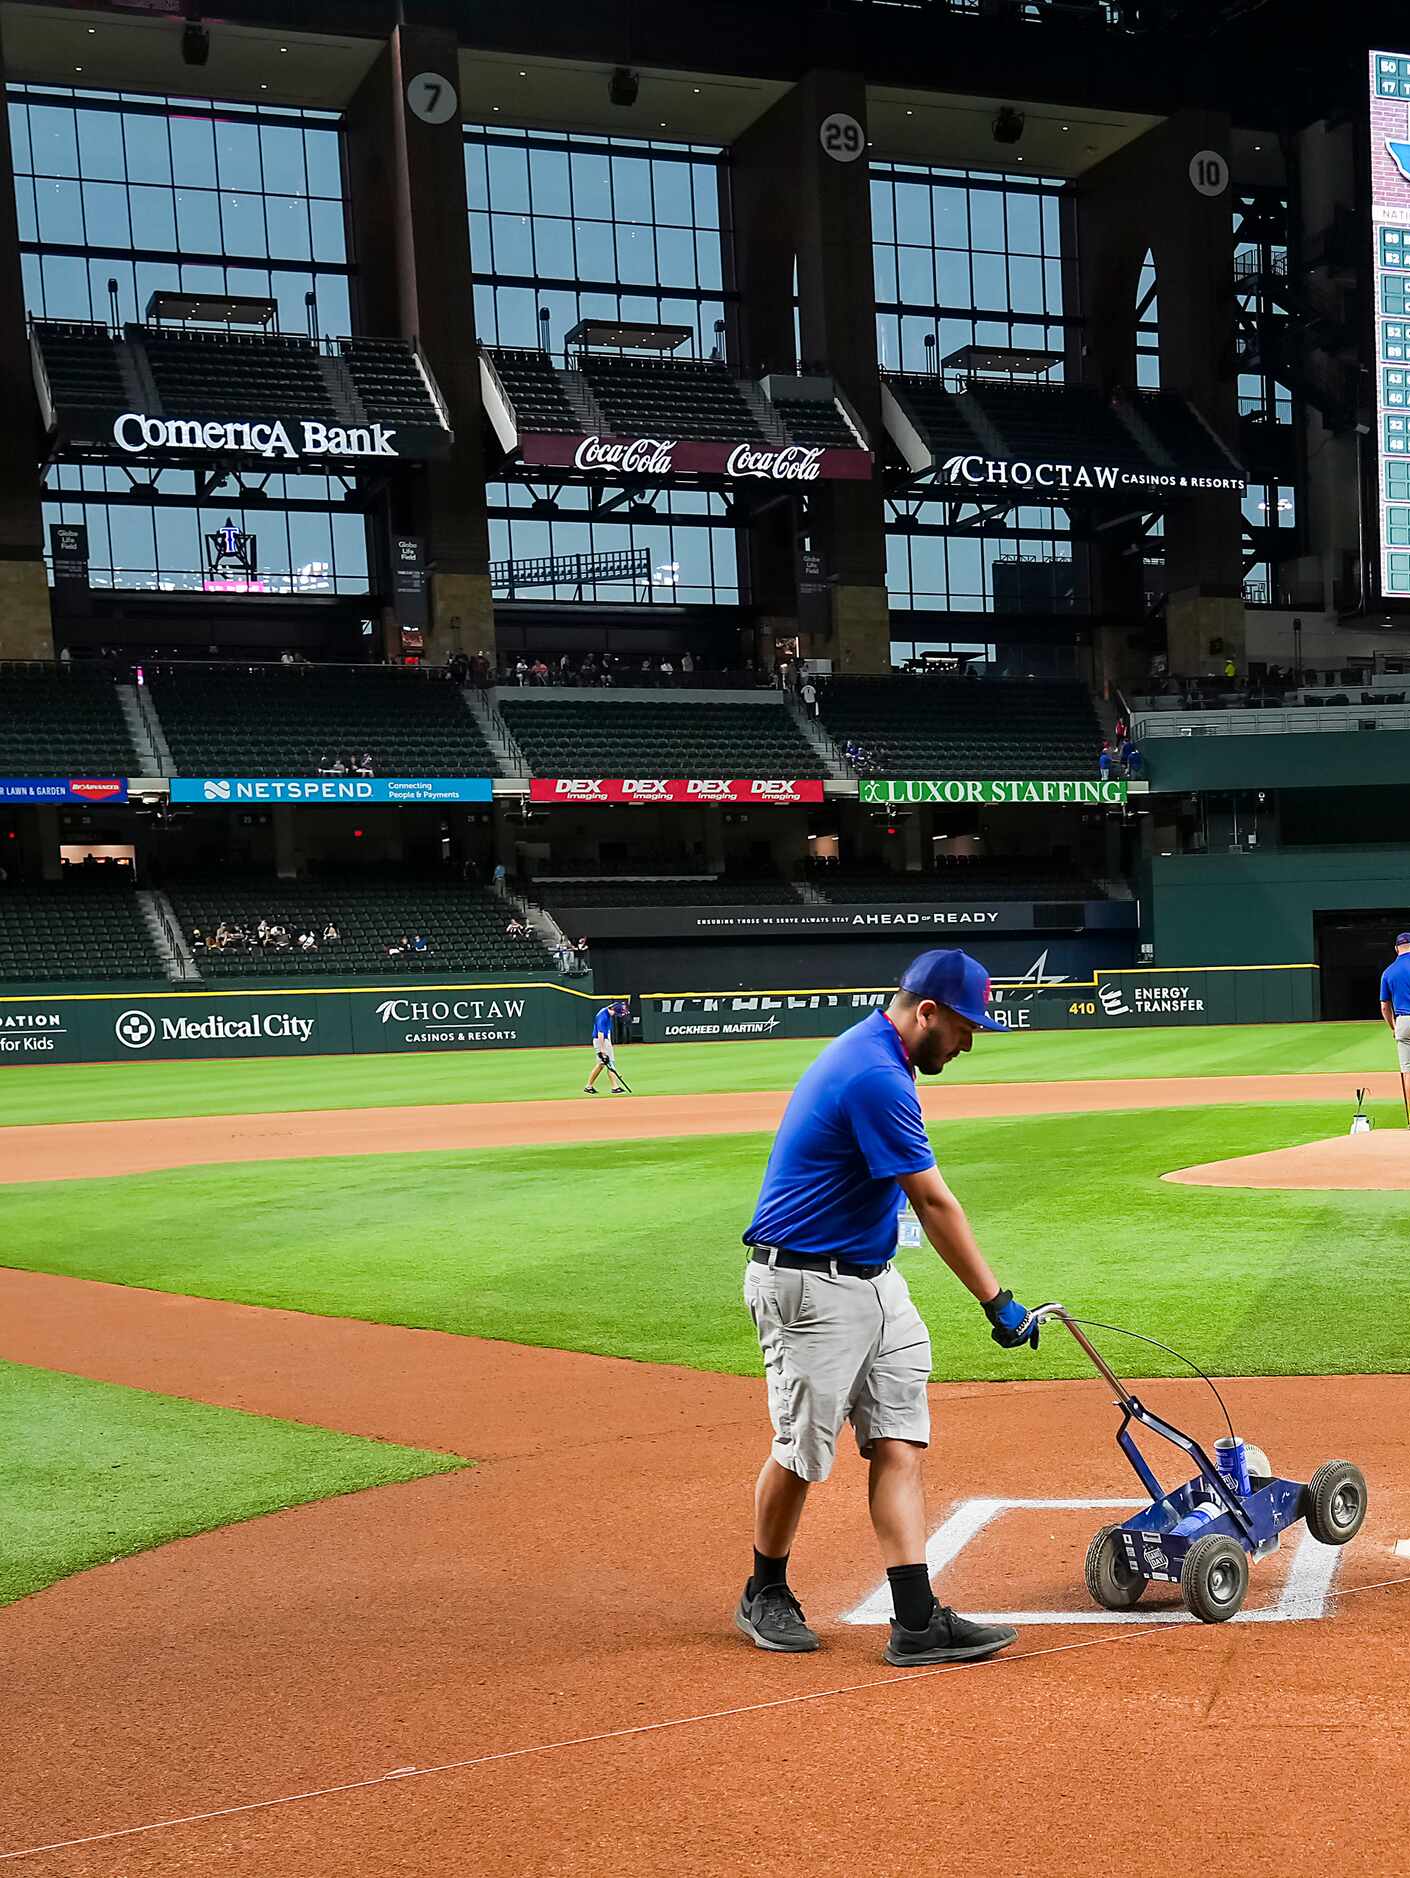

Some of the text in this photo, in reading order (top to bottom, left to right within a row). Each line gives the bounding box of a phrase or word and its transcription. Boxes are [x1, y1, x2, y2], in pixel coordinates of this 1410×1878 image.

[424, 83, 442, 112] 7
[826, 124, 858, 152] 29
[1197, 160, 1220, 186] 10
[301, 421, 399, 456] Bank
[575, 436, 677, 474] Coca-Cola
[727, 443, 825, 480] Coca-Cola
[961, 456, 1245, 489] CHOCTAW CASINOS & RESORTS
[6, 787, 27, 796] LAWN
[29, 787, 35, 796] &
[36, 787, 66, 796] GARDEN
[237, 783, 373, 797] NETSPEND
[388, 782, 432, 792] Connecting
[555, 779, 603, 793] DEX
[622, 779, 669, 793] DEX
[687, 779, 734, 793] DEX
[751, 779, 797, 793] DEX
[888, 780, 1122, 802] LUXOR STAFFING
[388, 790, 459, 801] People & Payments
[852, 913, 920, 925] AHEAD
[933, 911, 999, 924] READY
[1135, 987, 1190, 999] ENERGY
[391, 1000, 526, 1021] CHOCTAW
[1069, 1002, 1096, 1015] 410
[1136, 1000, 1205, 1013] TRANSFER
[0, 1015, 60, 1027] ATION
[161, 1014, 314, 1042] Medical City
[665, 1023, 763, 1036] LOCKHEED MARTIN
[0, 1036, 54, 1051] for Kids
[405, 1031, 517, 1043] CASINOS & RESORTS
